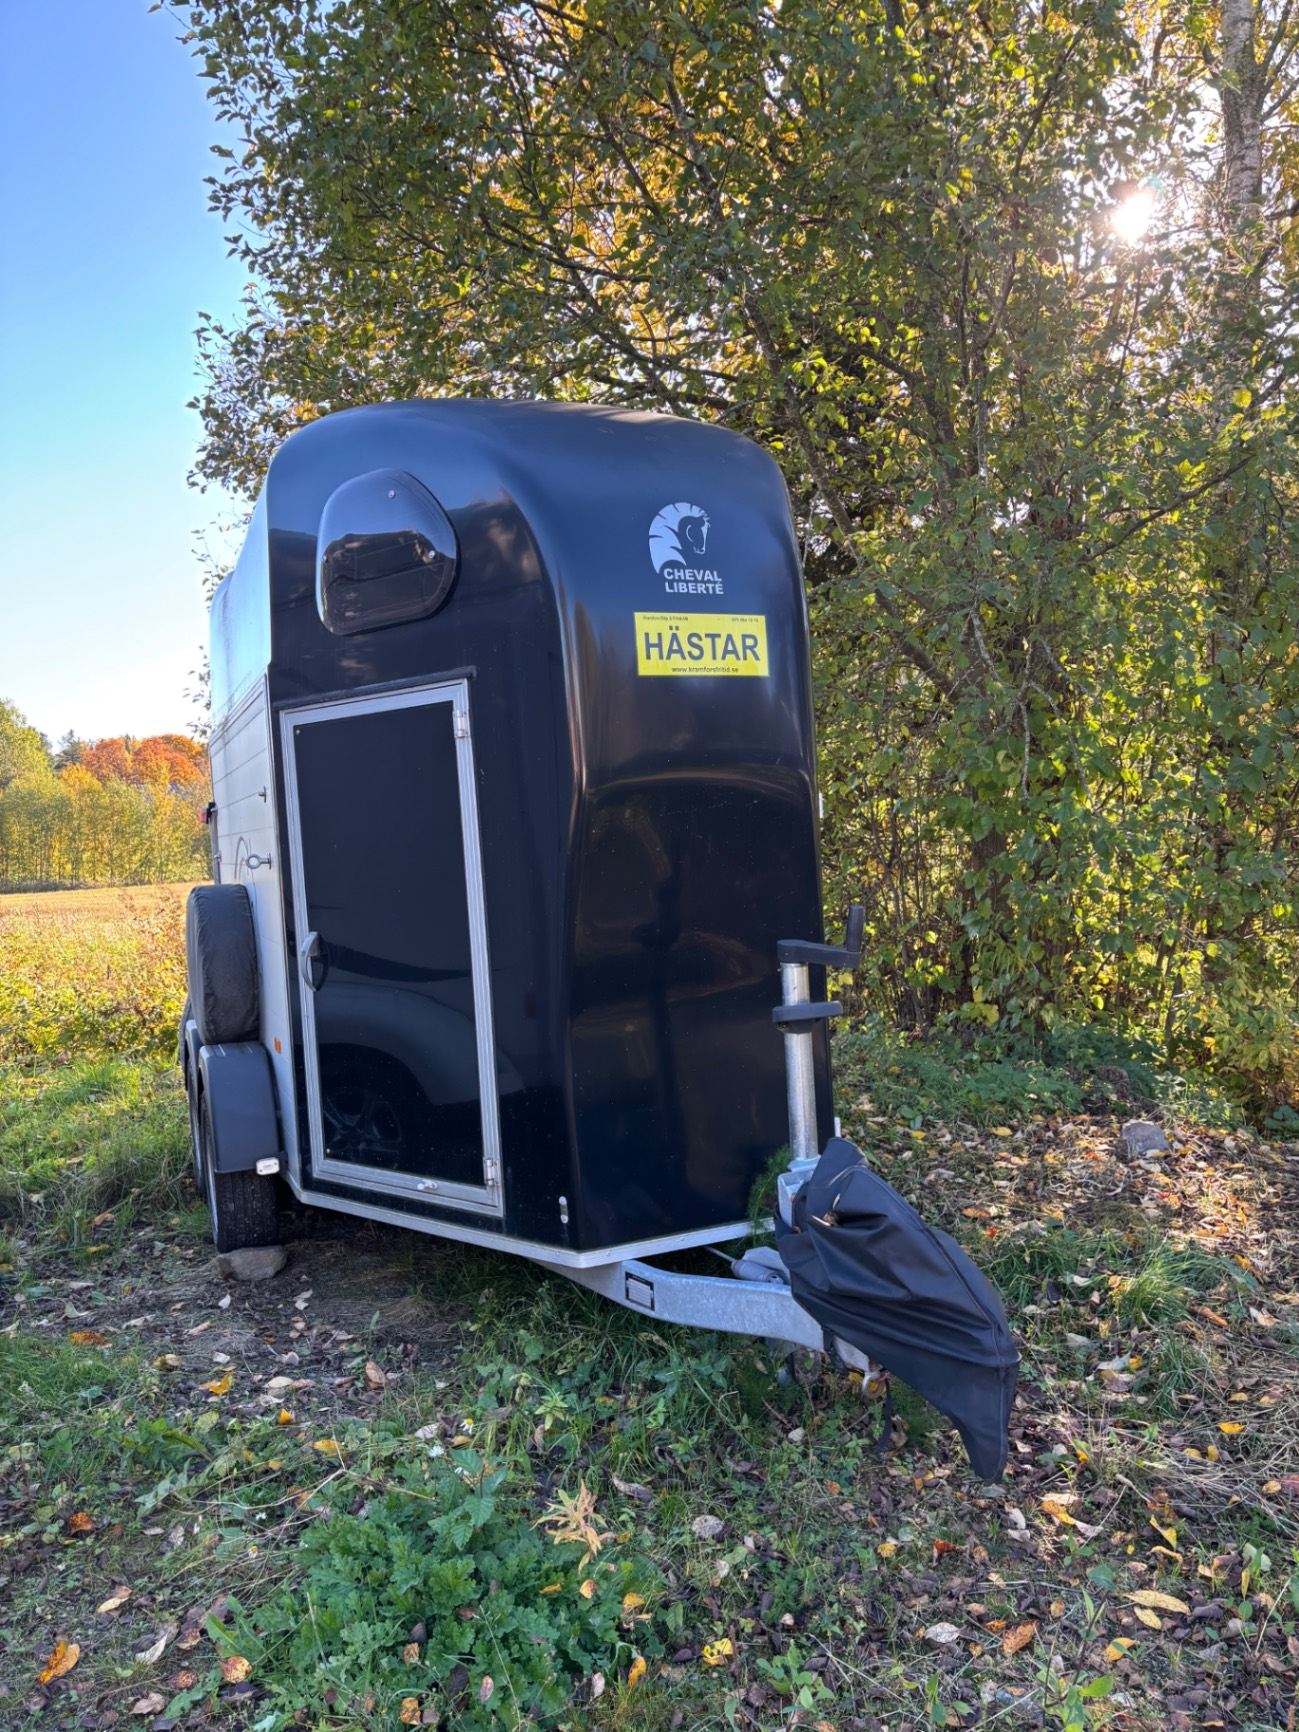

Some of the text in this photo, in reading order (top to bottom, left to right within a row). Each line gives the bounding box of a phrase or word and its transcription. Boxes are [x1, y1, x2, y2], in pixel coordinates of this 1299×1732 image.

[663, 568, 722, 582] CHEVAL
[665, 580, 724, 595] LIBERTÉ
[644, 625, 760, 661] HÄSTAR
